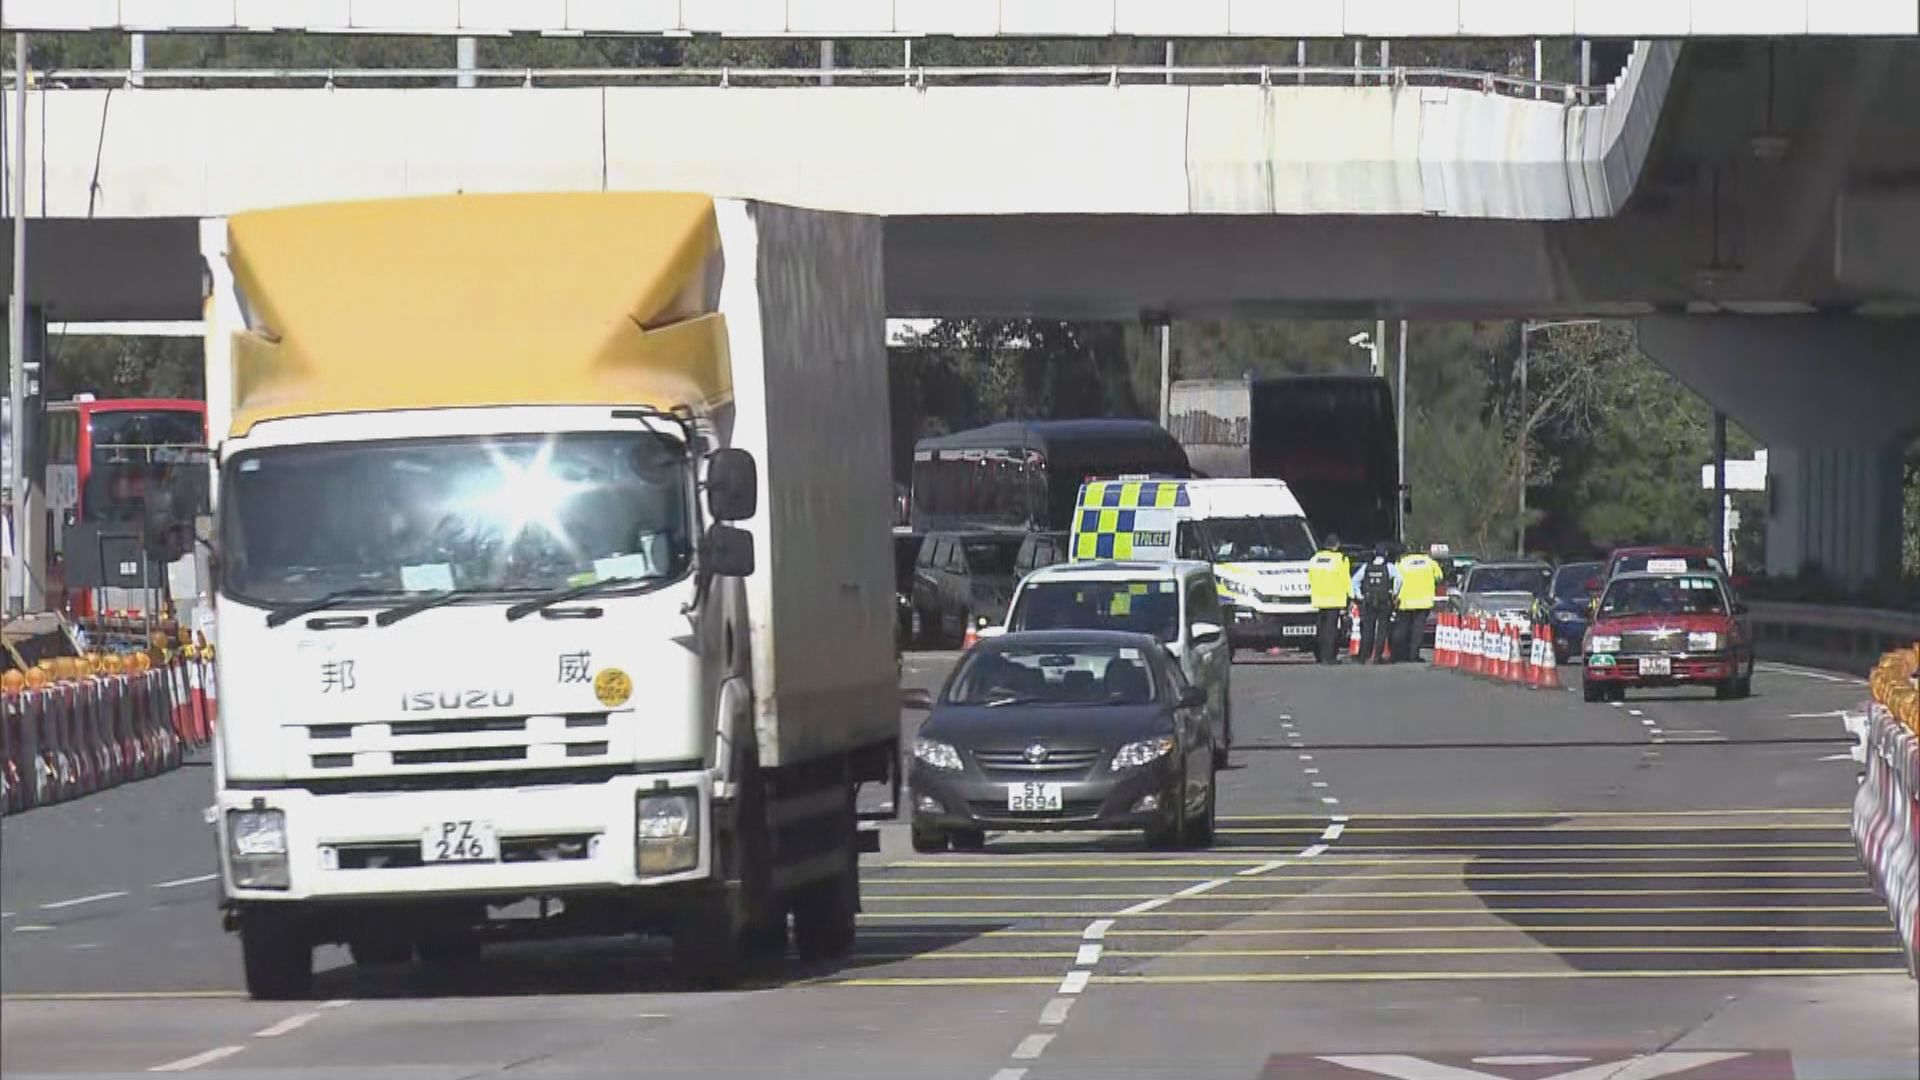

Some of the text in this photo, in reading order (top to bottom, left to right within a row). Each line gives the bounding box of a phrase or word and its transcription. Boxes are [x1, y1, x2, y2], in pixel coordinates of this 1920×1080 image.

[320, 650, 592, 693] 邦 威
[401, 689, 514, 711] ISUZU
[1025, 782, 1045, 796] SY
[1012, 796, 1057, 809] 2694
[442, 821, 473, 840] PZ
[436, 839, 483, 859] 246
